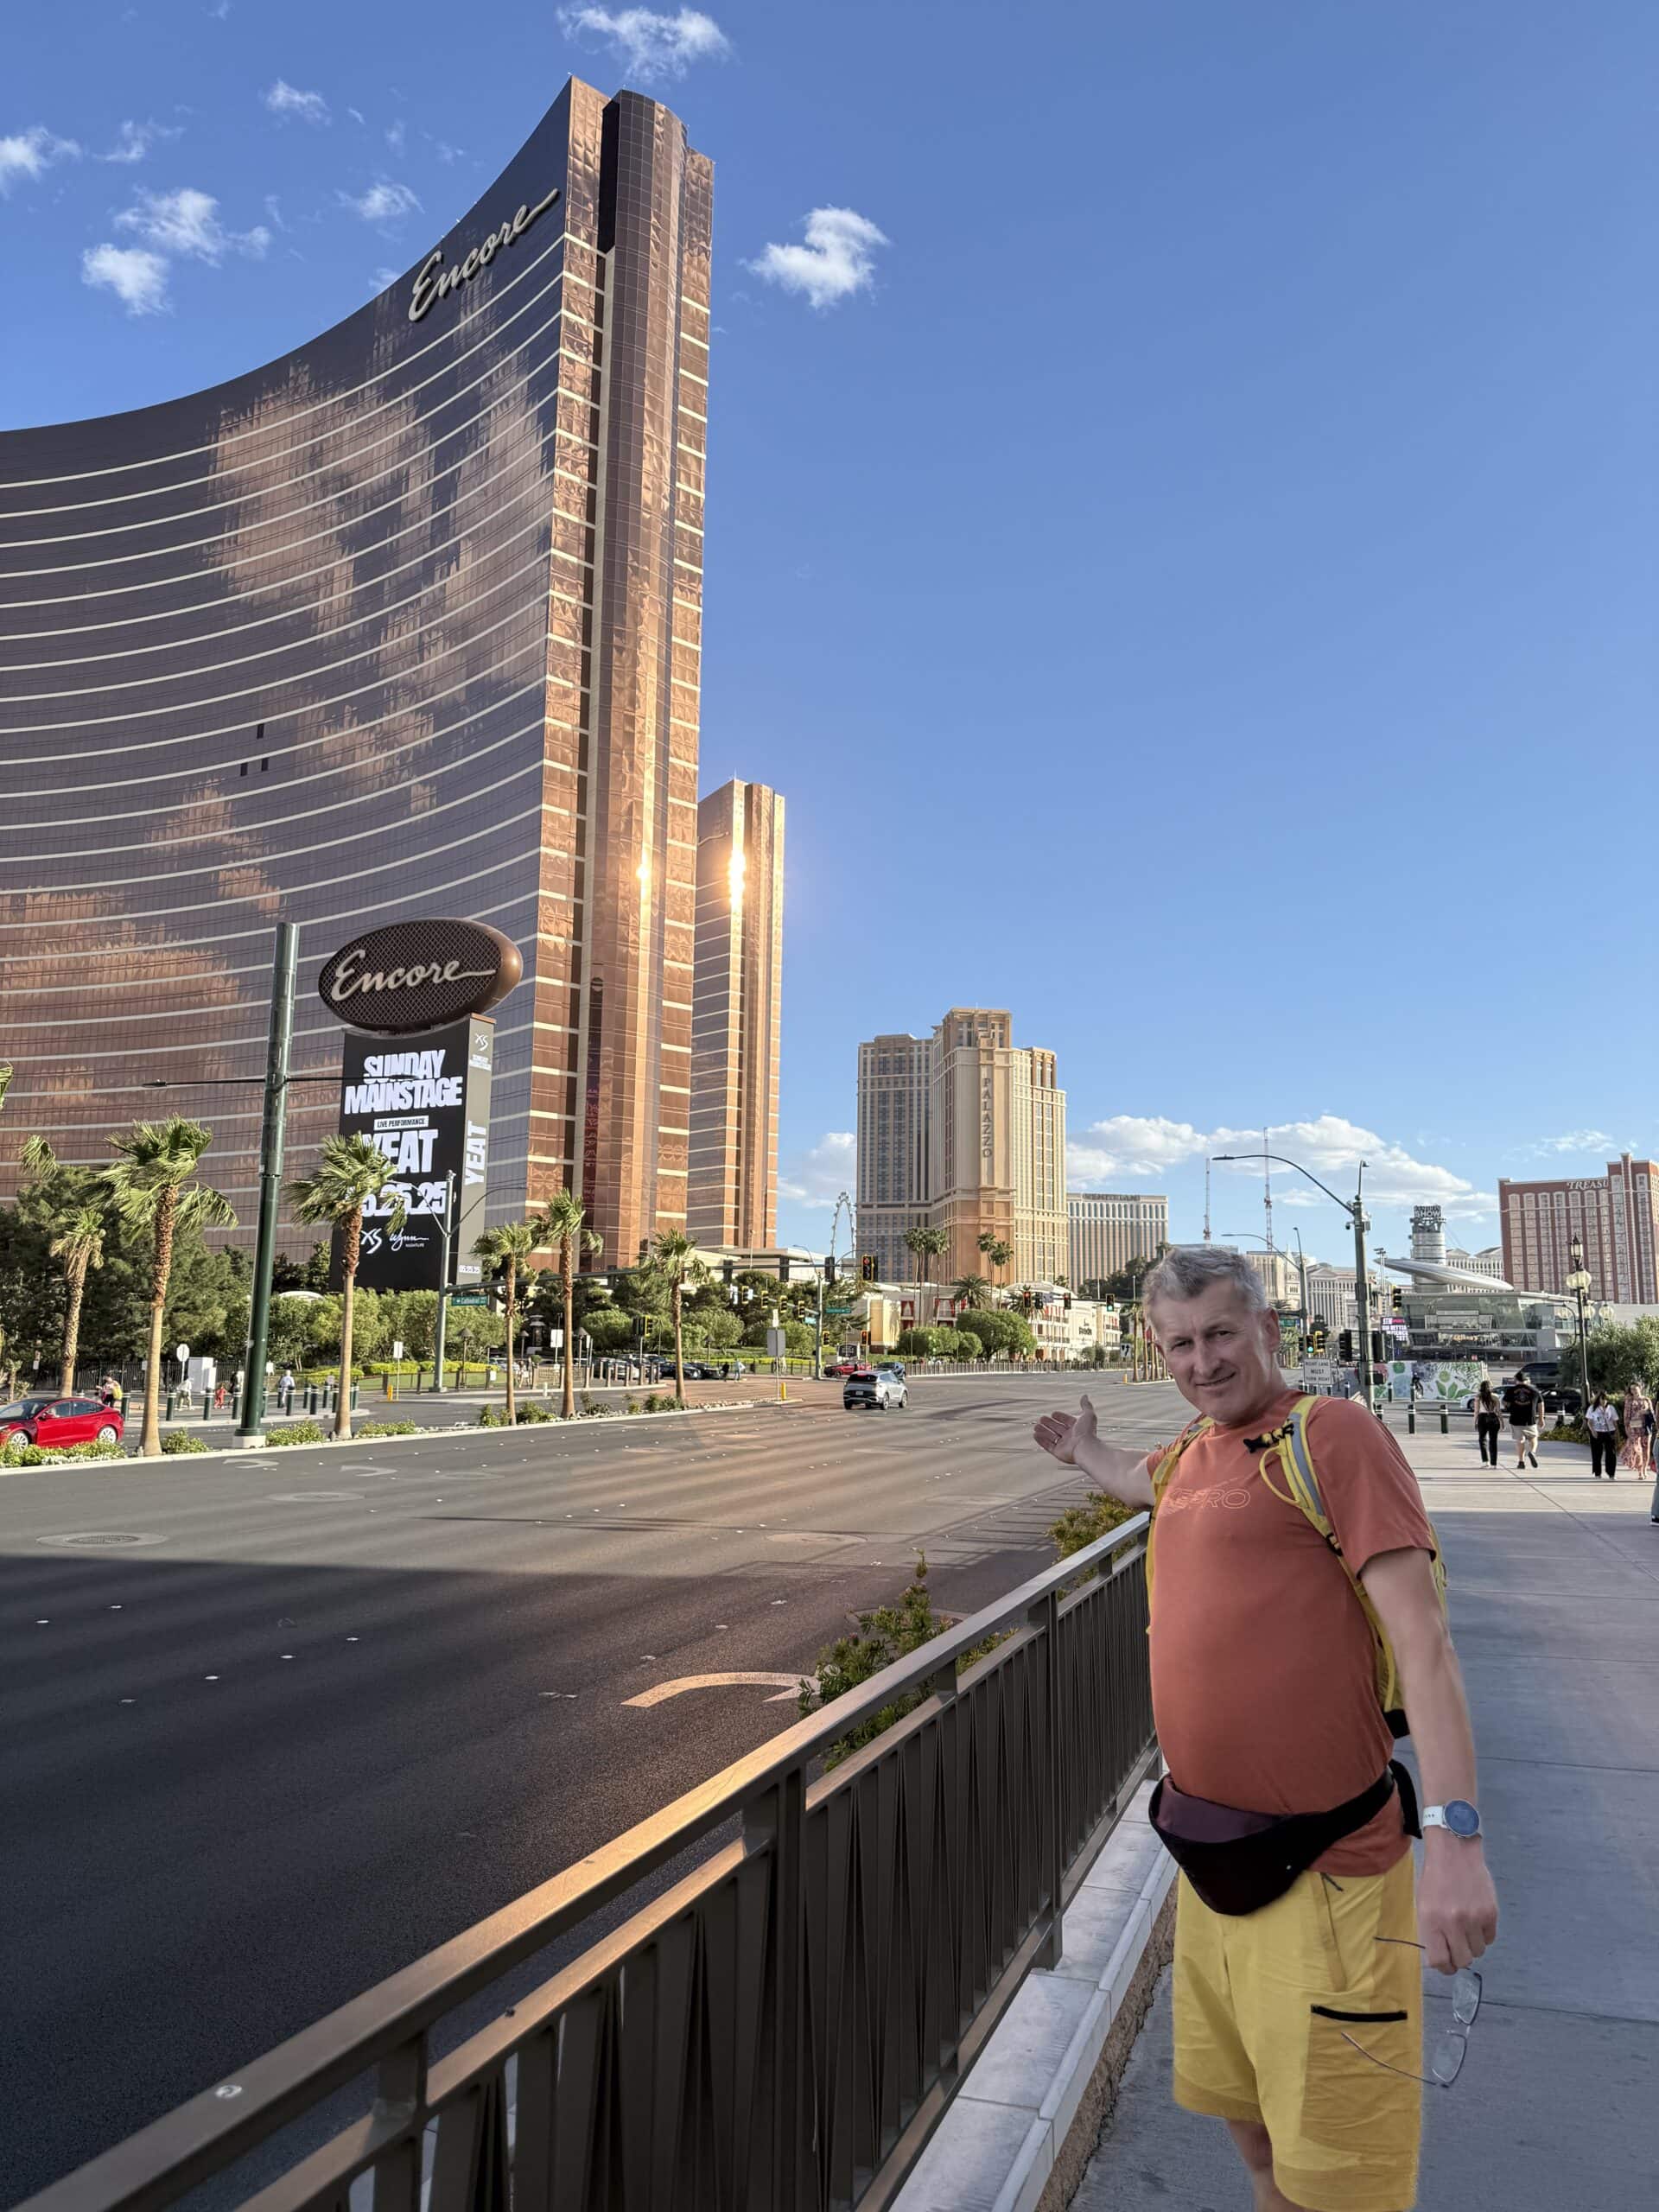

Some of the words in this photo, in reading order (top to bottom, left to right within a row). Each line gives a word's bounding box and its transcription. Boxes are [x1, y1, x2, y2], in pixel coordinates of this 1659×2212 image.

[409, 188, 559, 321] Encore
[331, 949, 497, 1001] Encore
[474, 1033, 488, 1052] XS
[363, 1049, 446, 1084] SUNDAY
[344, 1077, 463, 1115] MAINSTAGE
[388, 1118, 425, 1127] PERFORMANCE
[982, 1077, 993, 1158] PALAZZO
[464, 1121, 487, 1185] YEAT
[359, 1228, 382, 1254] XS
